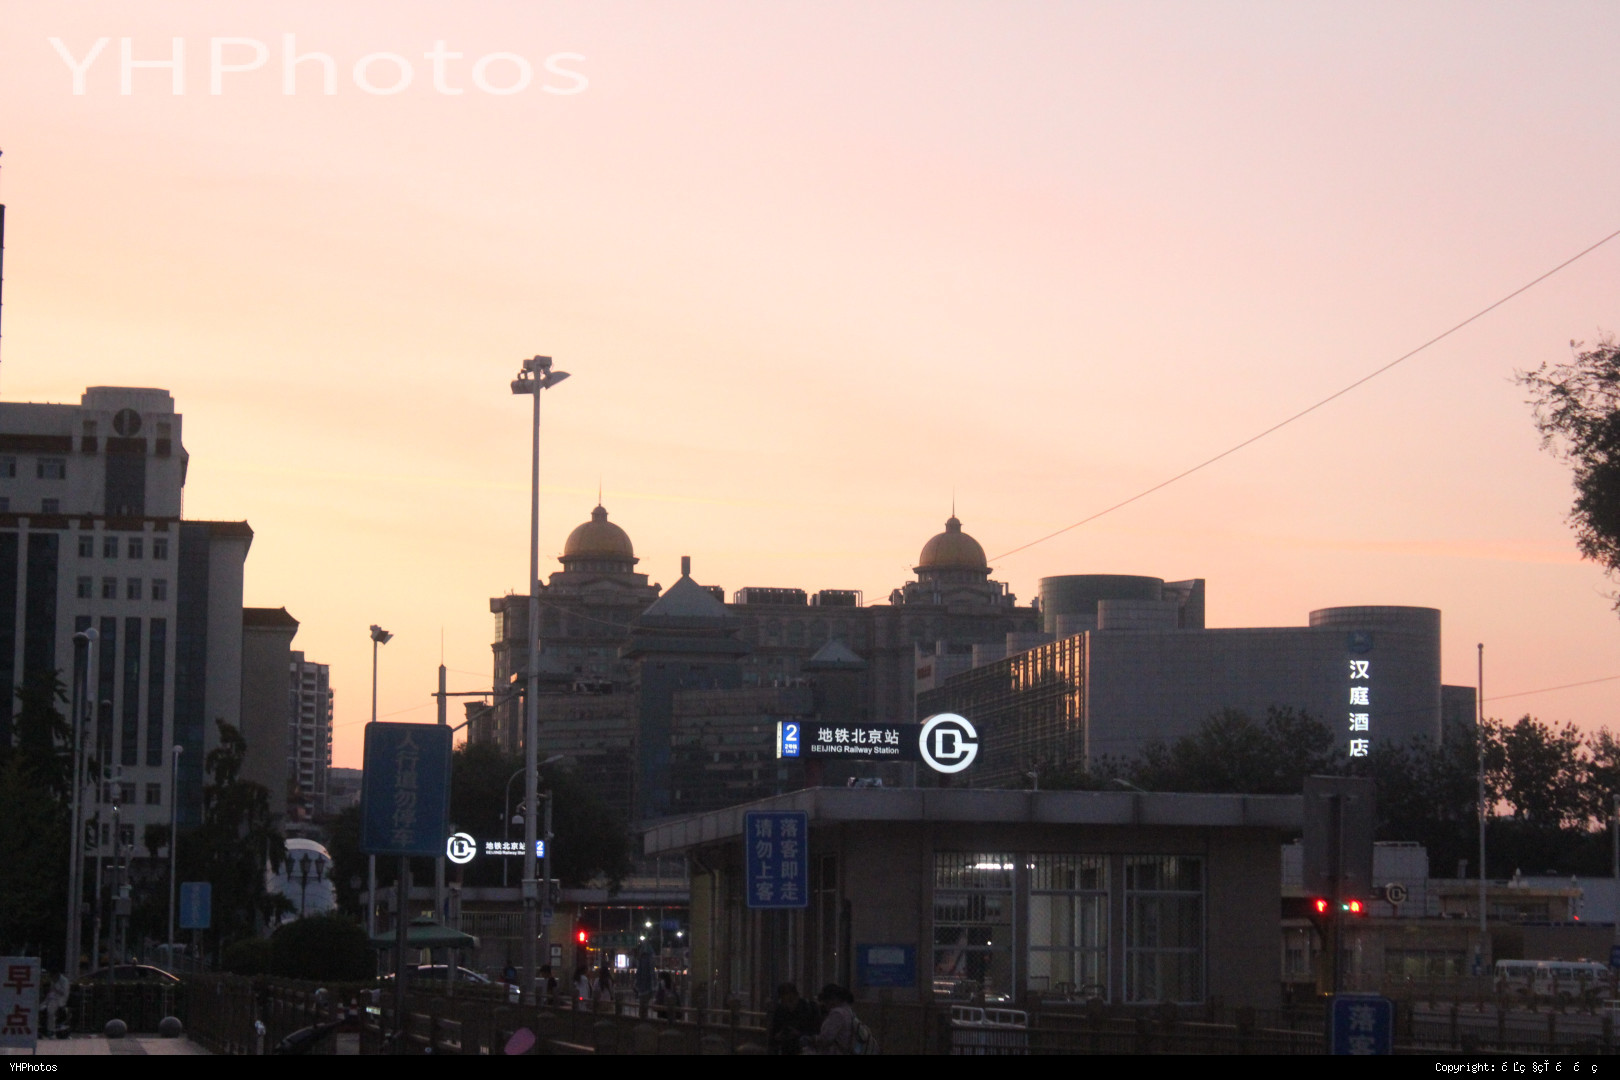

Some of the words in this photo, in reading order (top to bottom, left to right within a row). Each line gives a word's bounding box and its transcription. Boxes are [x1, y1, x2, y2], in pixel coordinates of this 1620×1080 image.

[1349, 659, 1370, 757] 汉庭酒店
[785, 724, 798, 741] 2
[811, 744, 842, 753] BEIJING
[843, 745, 872, 755] Railway
[873, 746, 900, 755] Station
[817, 727, 899, 744] 地铁北京站
[536, 840, 544, 851] 2
[755, 818, 774, 902] 请勿上客
[780, 818, 799, 901] 落客即走
[2, 965, 35, 1035] 早点
